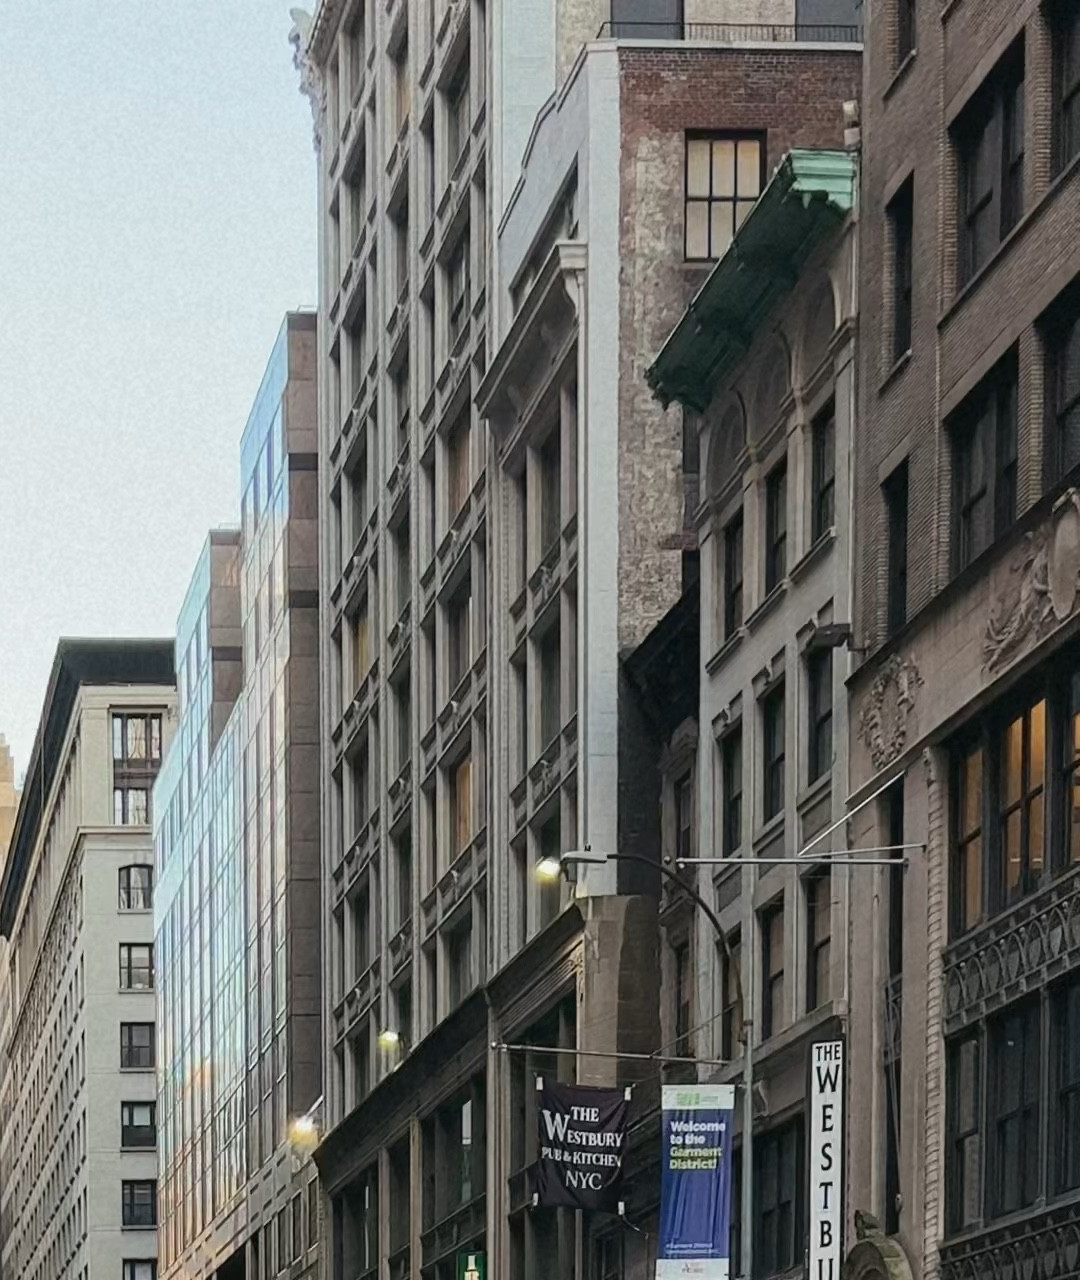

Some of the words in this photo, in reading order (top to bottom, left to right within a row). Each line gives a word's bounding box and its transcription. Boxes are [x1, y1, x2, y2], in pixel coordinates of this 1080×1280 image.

[815, 1043, 841, 1062] THE
[571, 1106, 600, 1122] THE
[542, 1109, 624, 1148] WESTBURY
[669, 1120, 726, 1133] Welcome
[669, 1134, 683, 1145] to
[684, 1133, 706, 1145] the
[541, 1146, 563, 1162] PUB
[669, 1146, 722, 1157] Garment
[565, 1169, 603, 1191] NYC
